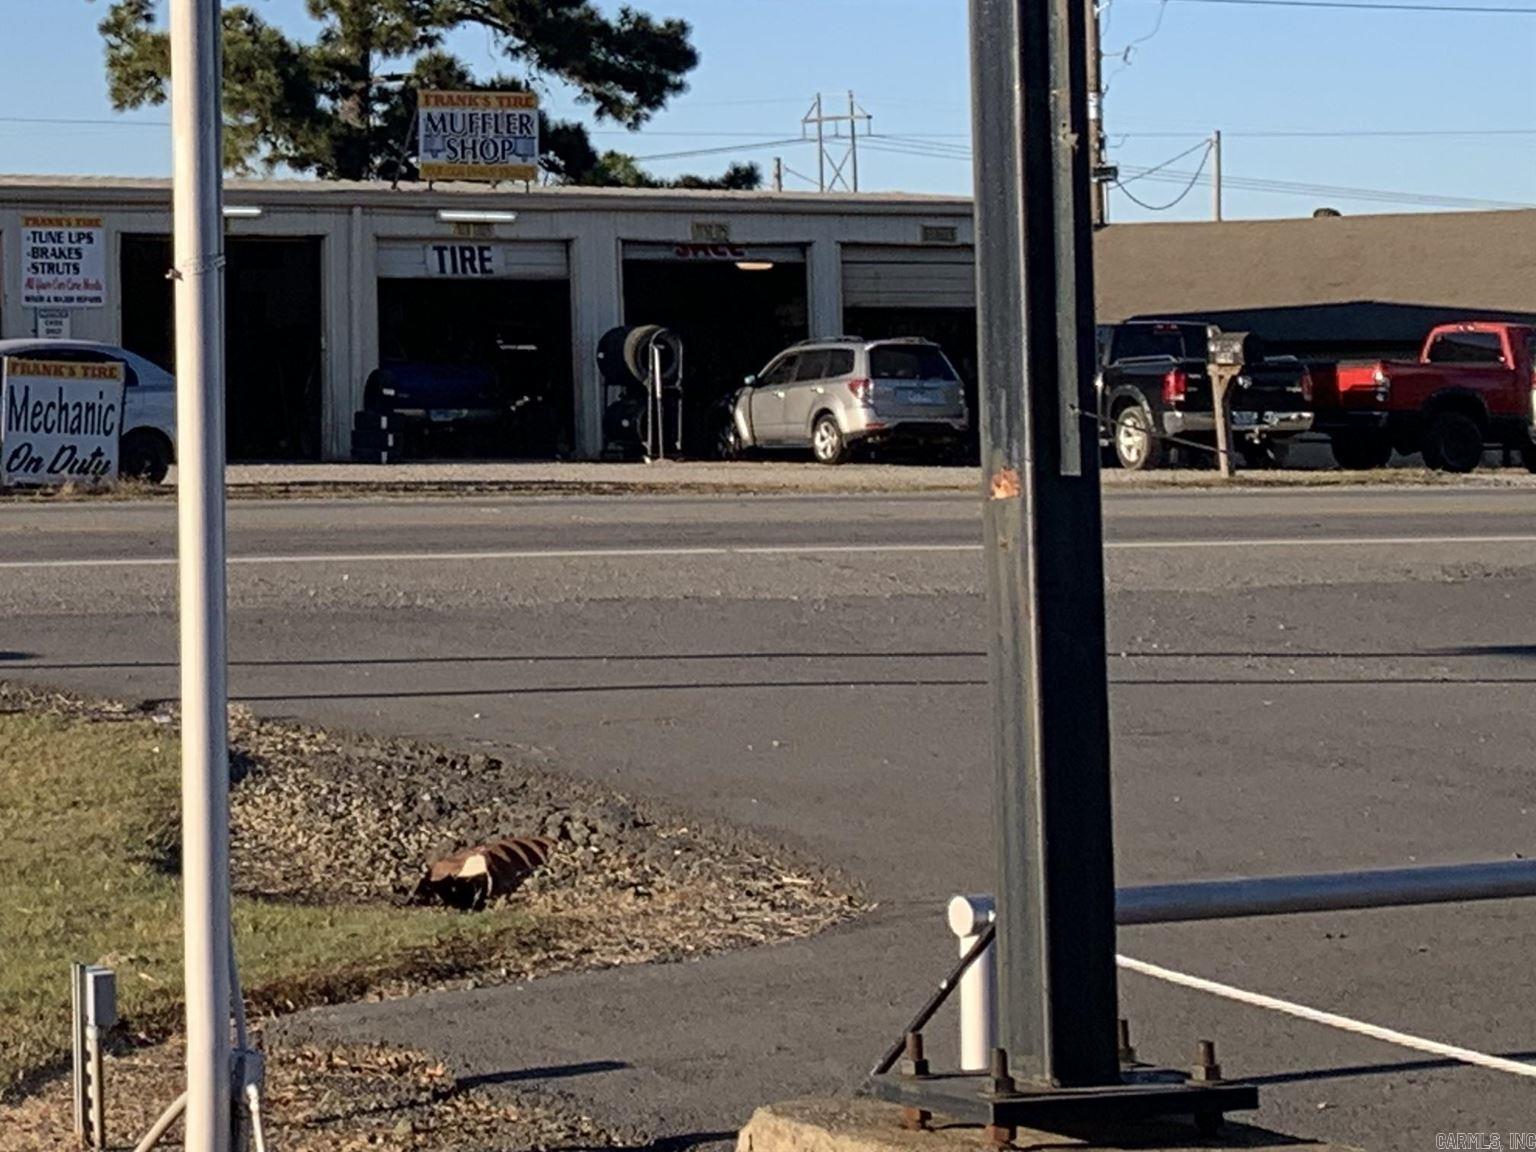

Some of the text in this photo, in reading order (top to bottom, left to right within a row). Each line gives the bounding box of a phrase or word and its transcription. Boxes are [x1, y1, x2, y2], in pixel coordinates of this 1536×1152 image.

[425, 94, 534, 107] FRANK'S TIRE
[426, 112, 536, 136] MUFFLER
[446, 137, 514, 163] SHOP
[31, 231, 94, 244] TUNE UPS
[31, 247, 83, 260] BRAKES
[432, 246, 496, 274] TIRE
[31, 262, 80, 275] STRUTS
[10, 361, 117, 379] FRANK'S TIRE
[7, 384, 116, 437] Mechanic
[5, 442, 112, 482] On Duty
